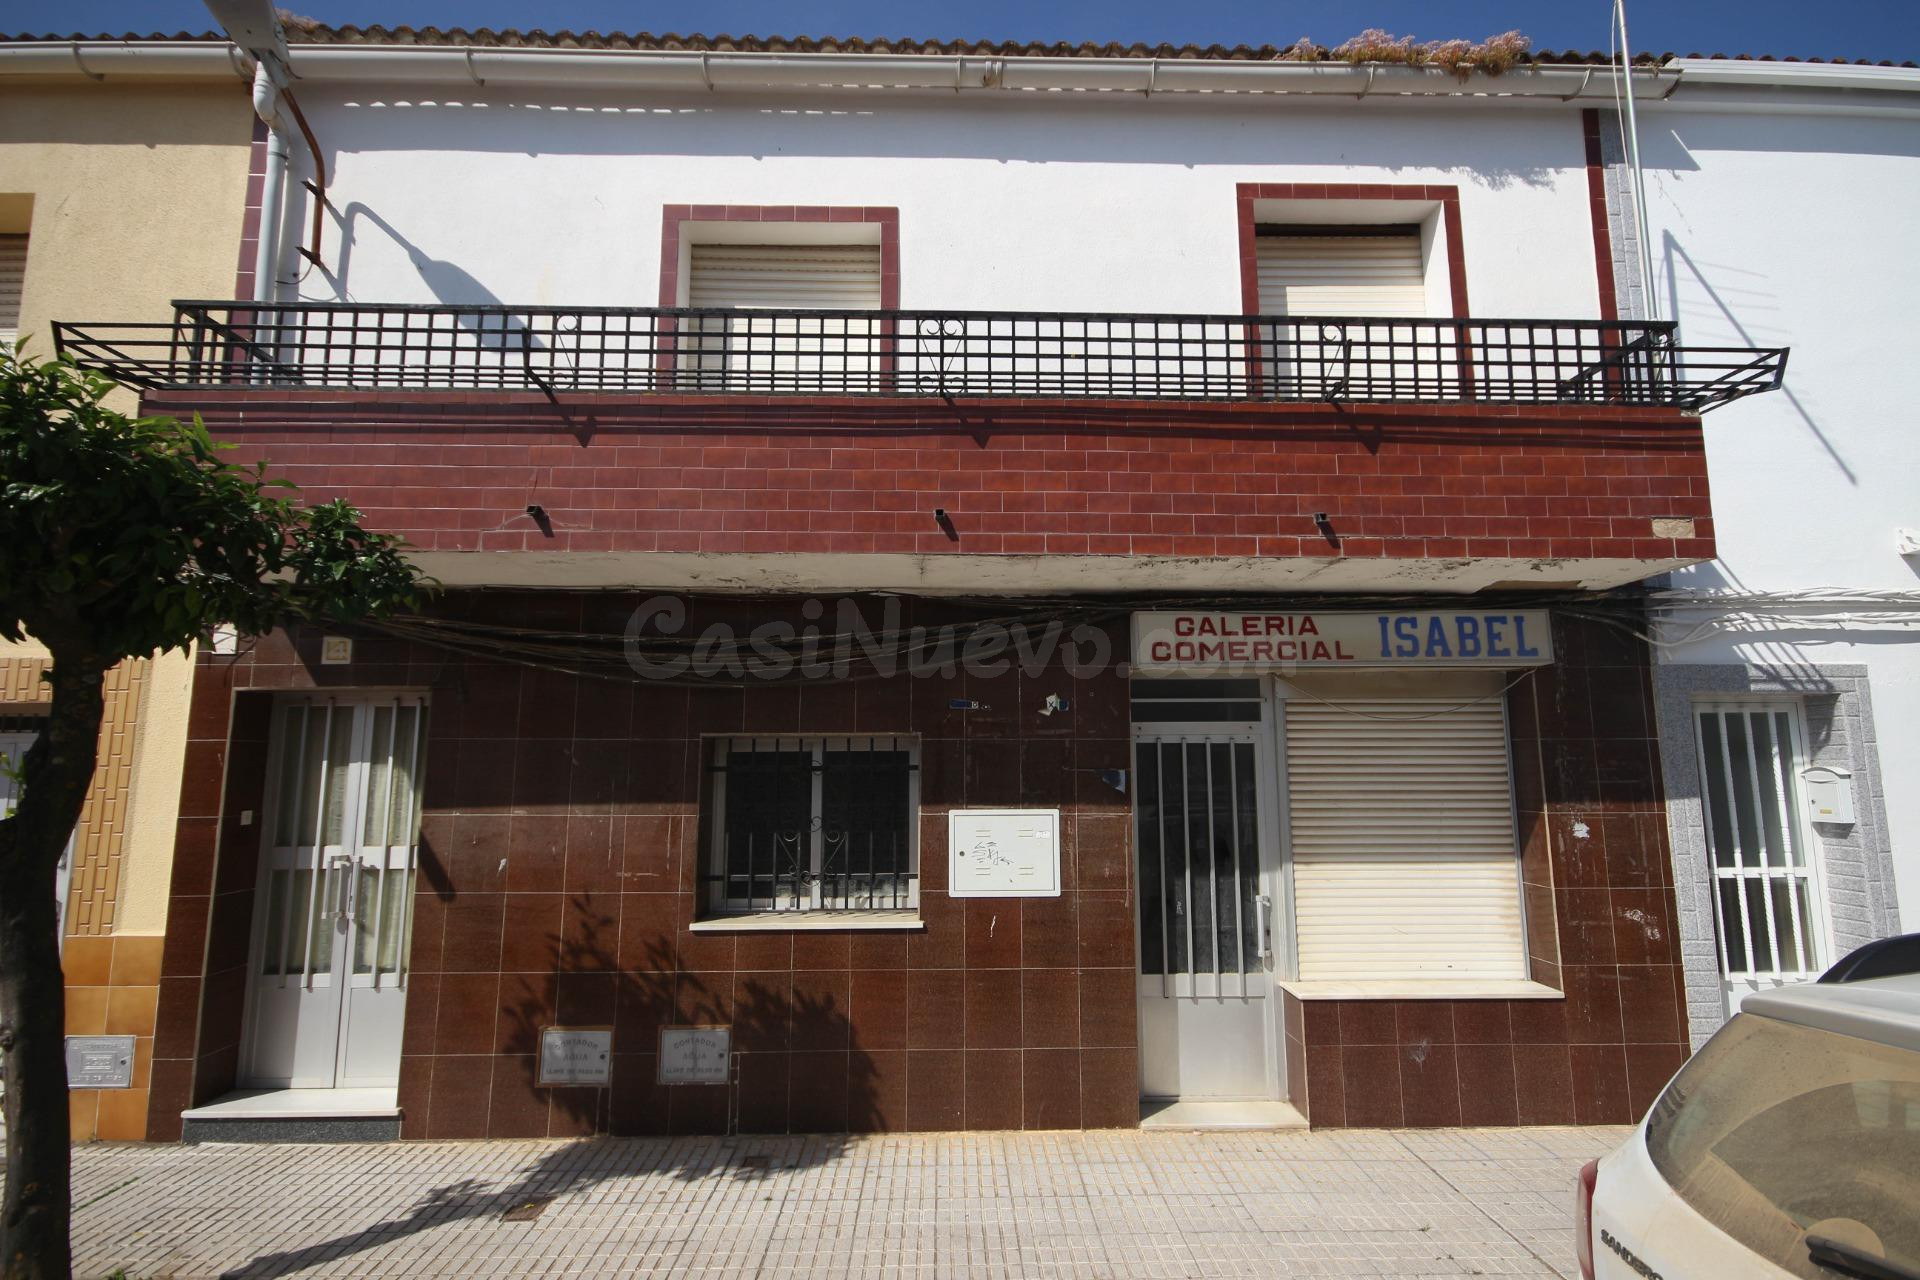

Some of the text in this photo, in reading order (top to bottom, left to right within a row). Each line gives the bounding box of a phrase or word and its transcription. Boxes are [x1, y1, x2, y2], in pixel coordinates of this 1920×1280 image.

[1174, 615, 1319, 637] GALERIA
[1377, 615, 1539, 658] ISABEL
[1151, 640, 1355, 662] COMERCIAL
